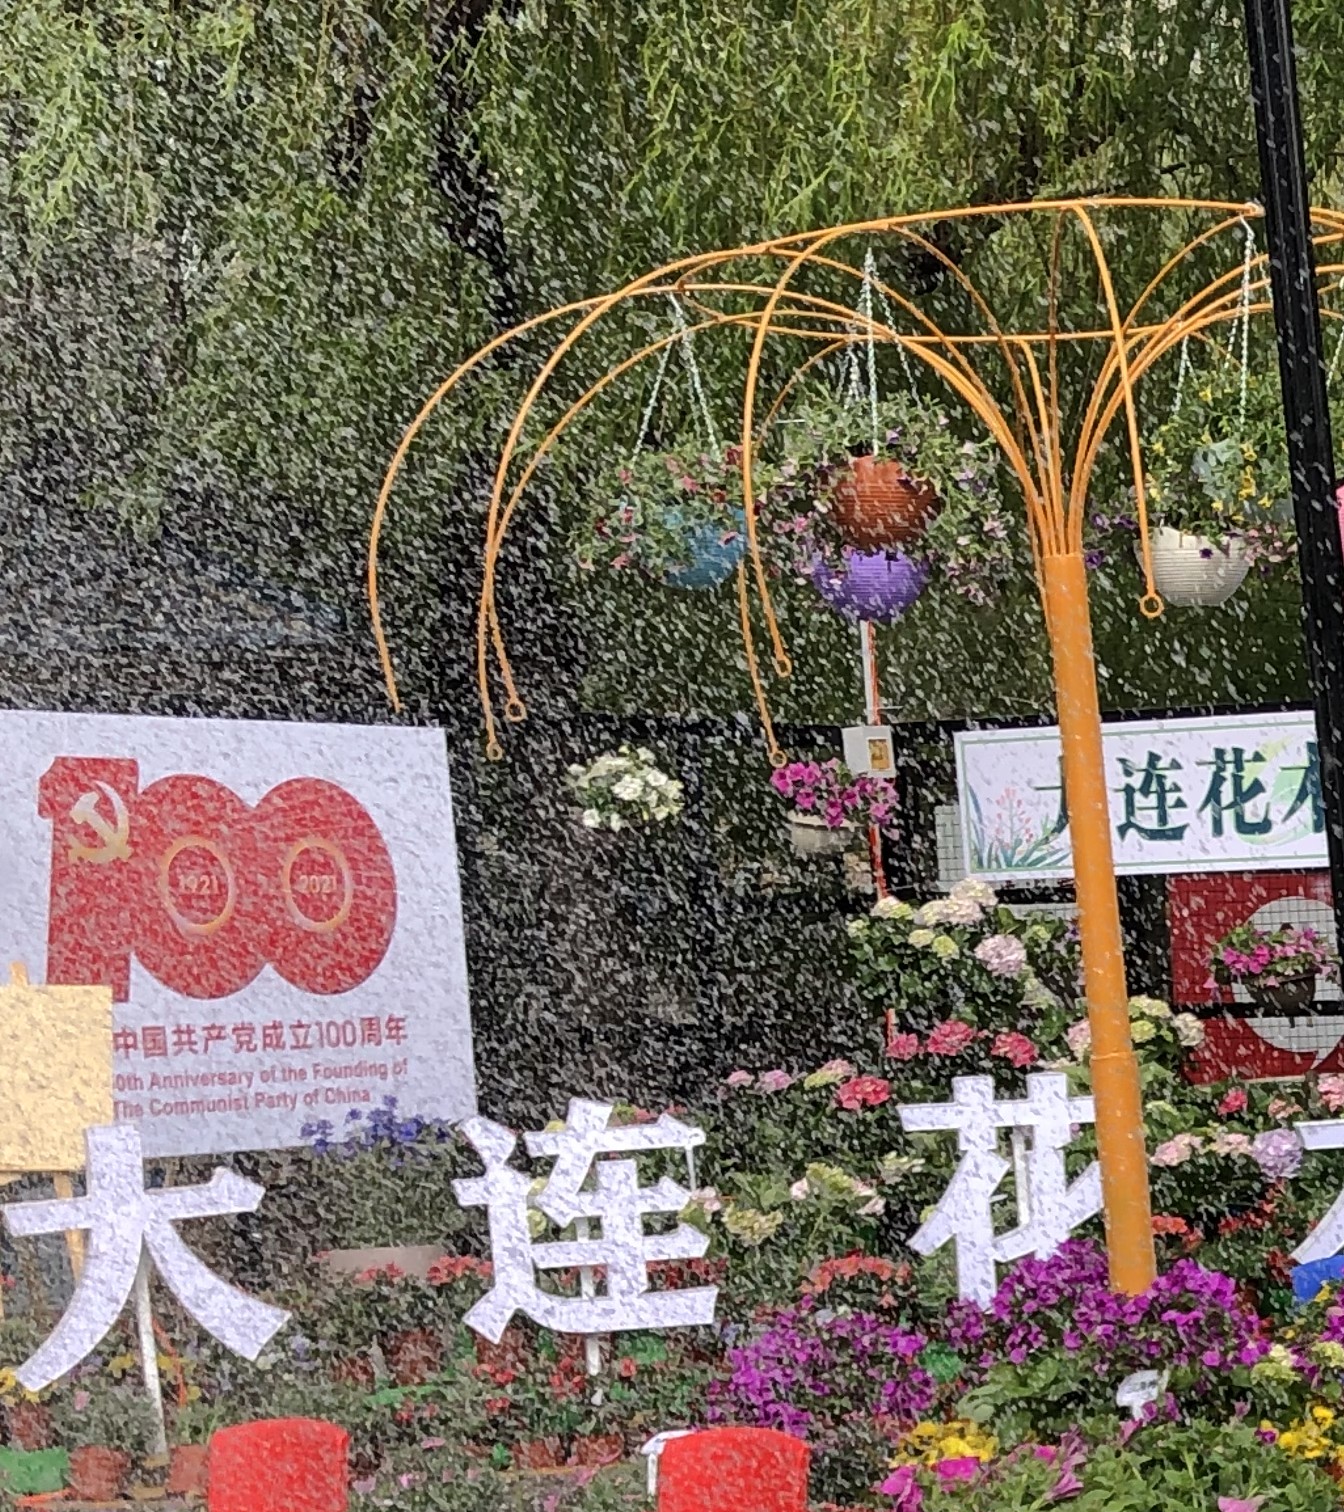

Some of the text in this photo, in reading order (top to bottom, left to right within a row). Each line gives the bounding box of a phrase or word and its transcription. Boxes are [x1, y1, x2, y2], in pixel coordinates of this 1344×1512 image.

[178, 873, 220, 895] 1921
[299, 874, 338, 894] 2021
[112, 1014, 408, 1059] 中国共产党成立100周年
[113, 1057, 408, 1092] 0th Anniversary of the Founding of
[149, 1094, 250, 1117] Communist
[254, 1090, 298, 1112] Party
[303, 1088, 320, 1107] of
[325, 1086, 371, 1105] China
